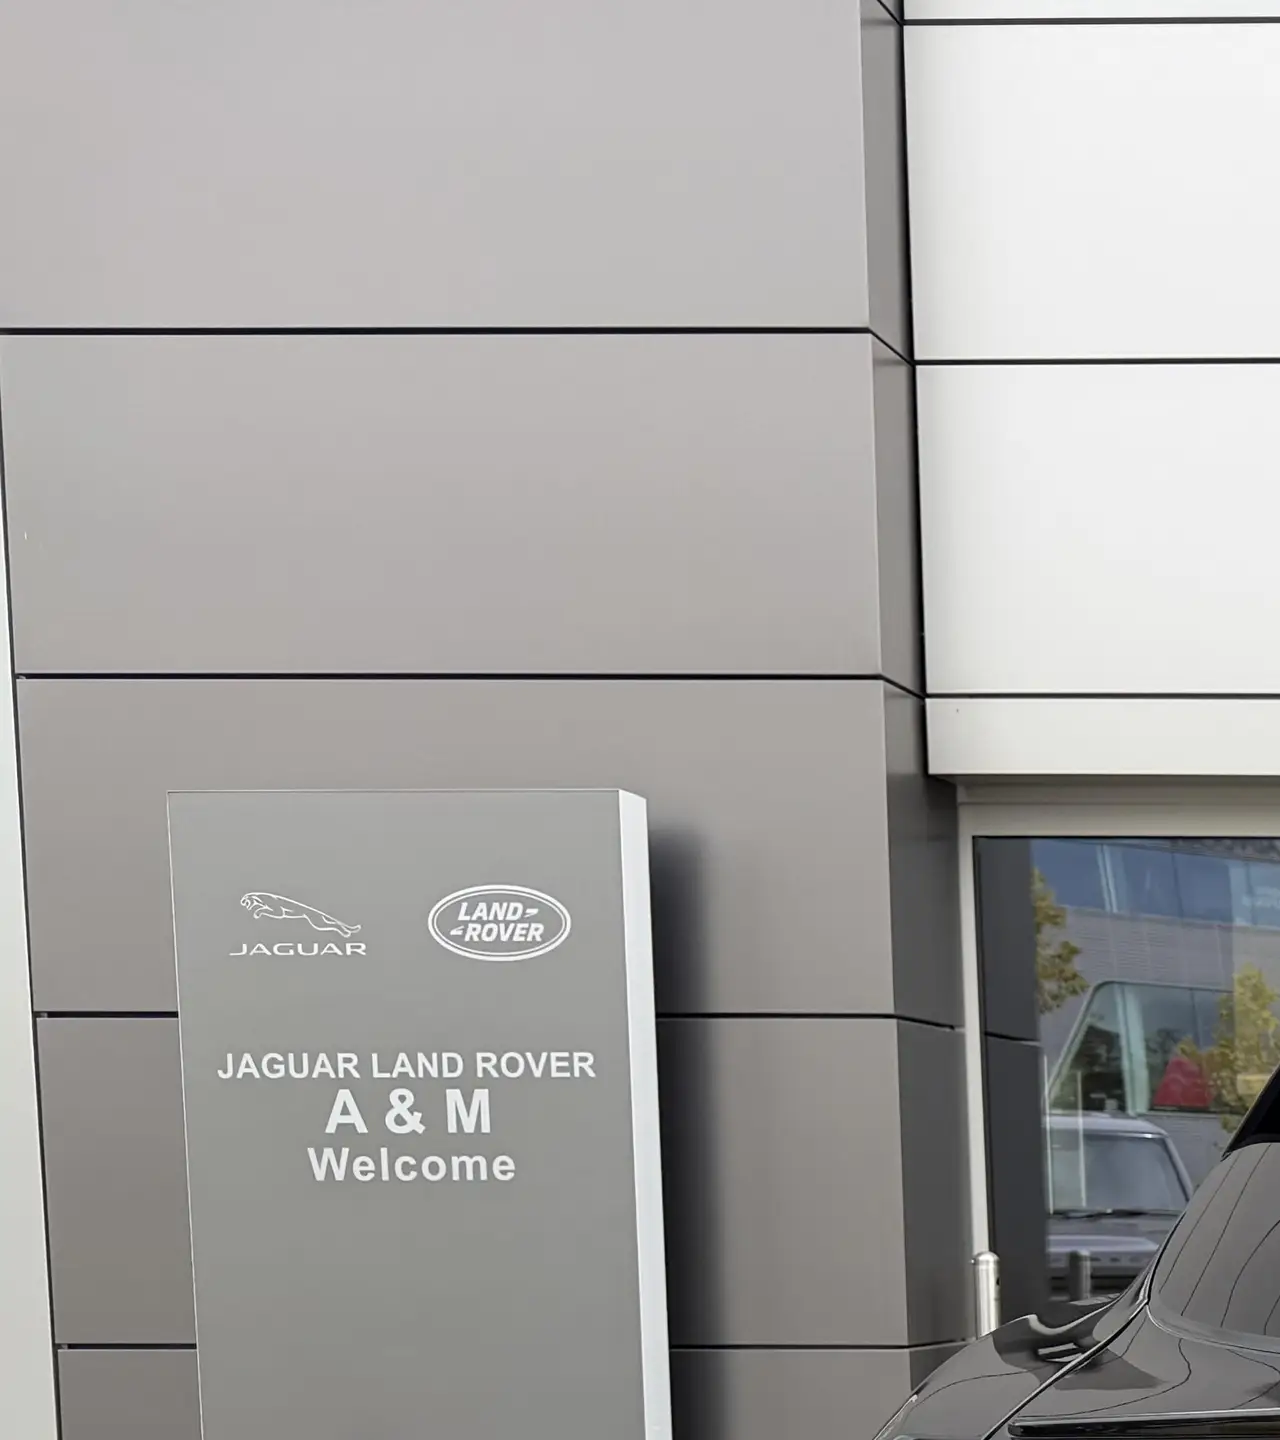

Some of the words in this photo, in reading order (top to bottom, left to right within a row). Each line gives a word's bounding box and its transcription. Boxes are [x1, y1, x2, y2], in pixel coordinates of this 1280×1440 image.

[458, 902, 523, 920] LAND
[464, 923, 544, 942] ROVER
[229, 942, 367, 956] JAGUAR
[217, 1052, 361, 1079] JAGUAR
[371, 1051, 464, 1079] LAND
[475, 1051, 596, 1078] ROVER
[324, 1088, 369, 1134] A
[384, 1088, 426, 1135] &
[445, 1088, 491, 1134] M
[307, 1147, 516, 1182] Welcome
